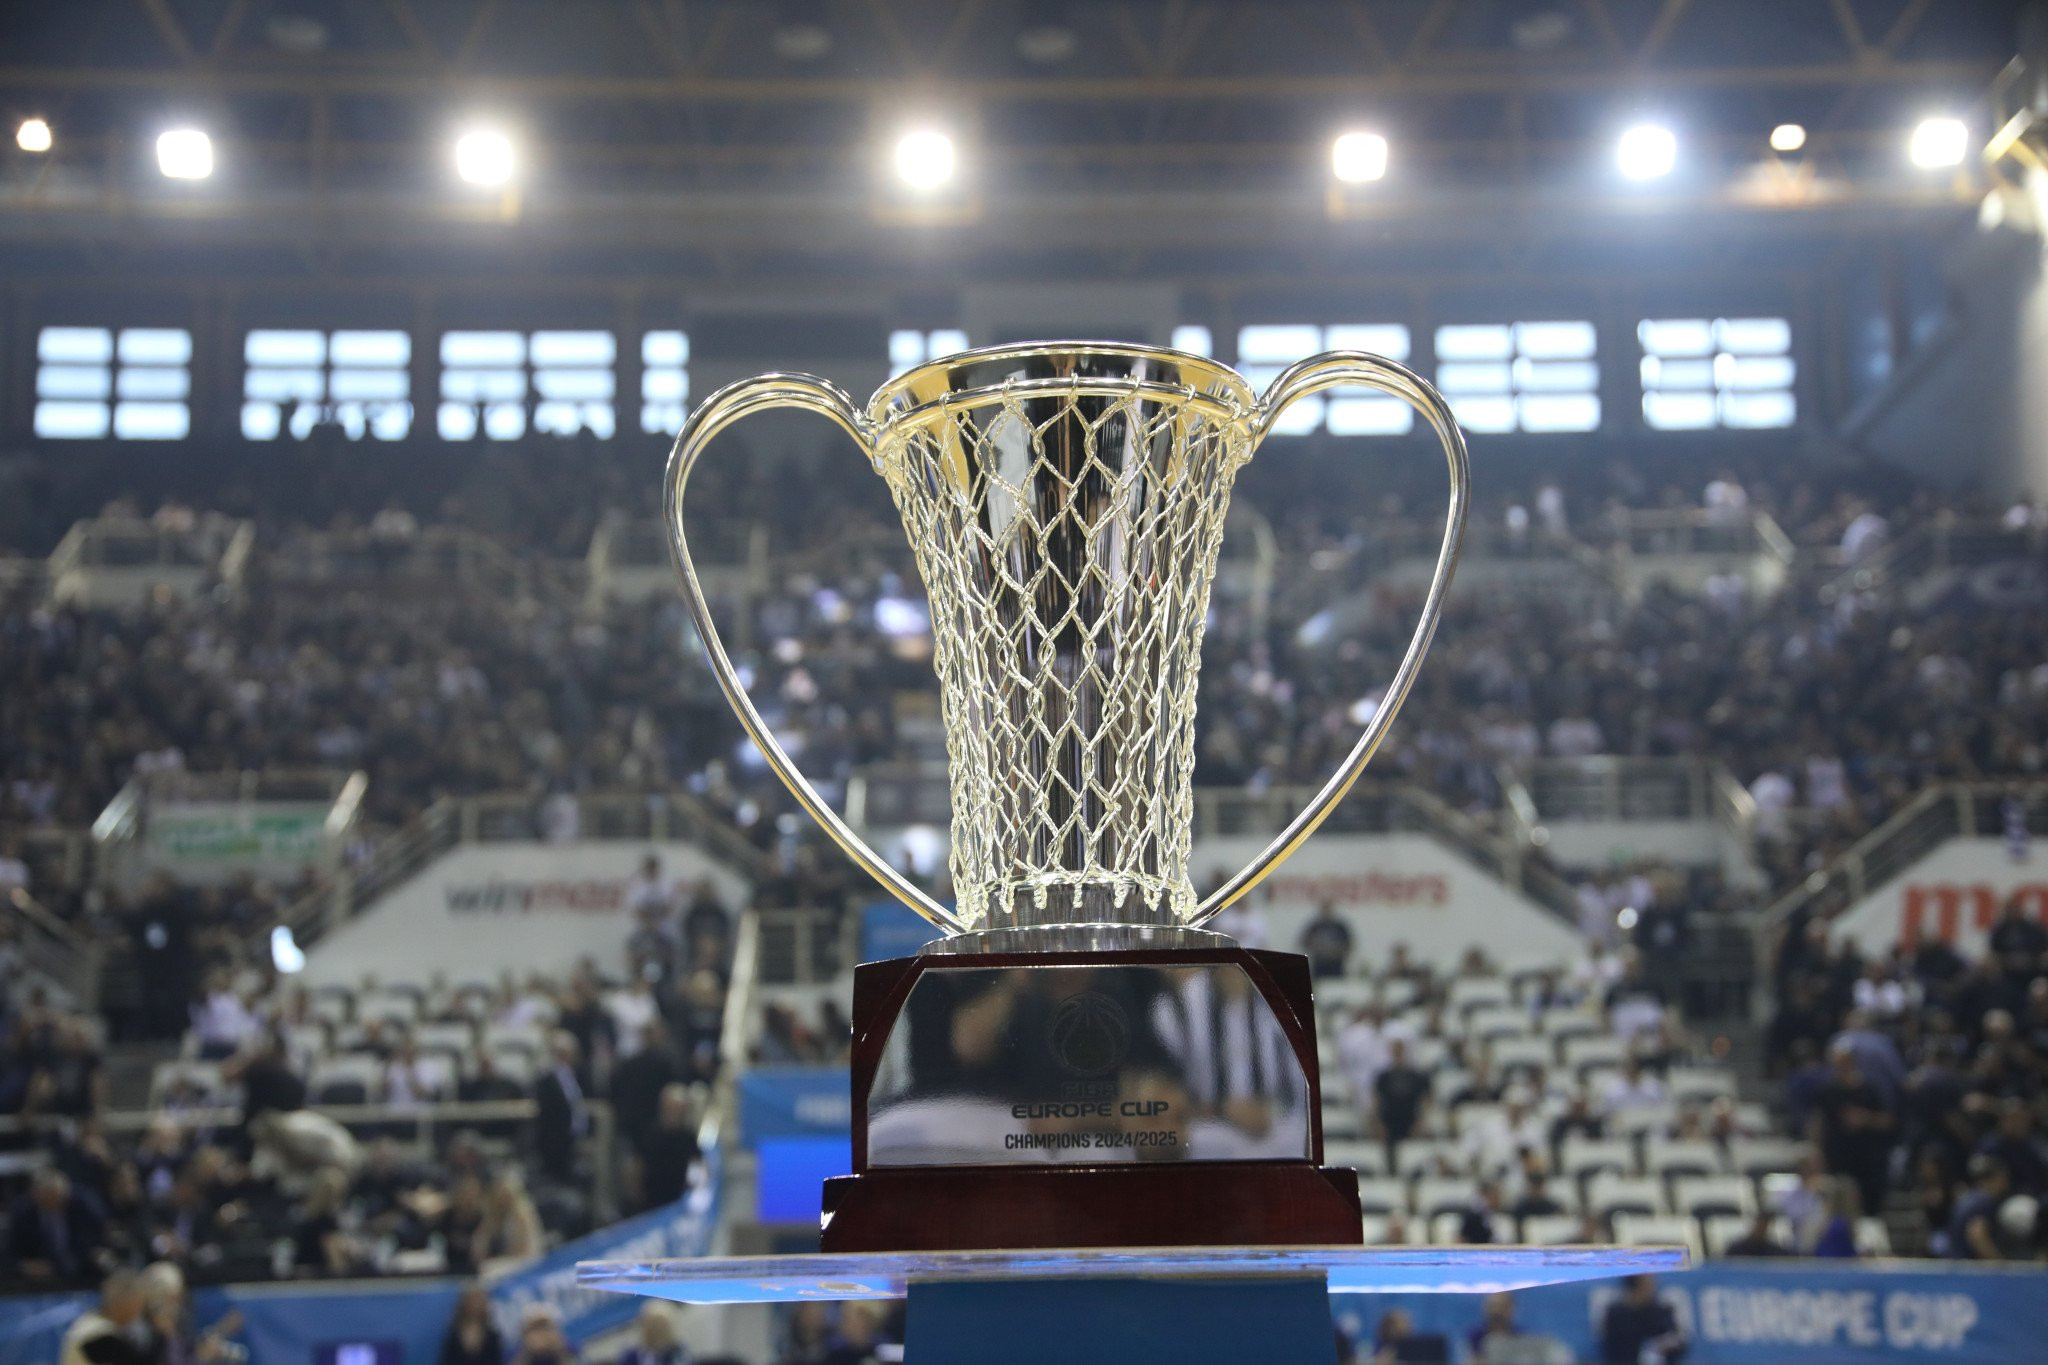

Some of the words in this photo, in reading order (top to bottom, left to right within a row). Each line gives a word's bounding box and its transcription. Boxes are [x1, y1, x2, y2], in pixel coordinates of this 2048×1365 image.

[1012, 1101, 1112, 1119] EUROPE
[1120, 1100, 1169, 1117] CUP
[1005, 1133, 1091, 1150] CHAMPIONS
[1094, 1130, 1178, 1148] 2024/2025
[1884, 1292, 1978, 1350] CUP
